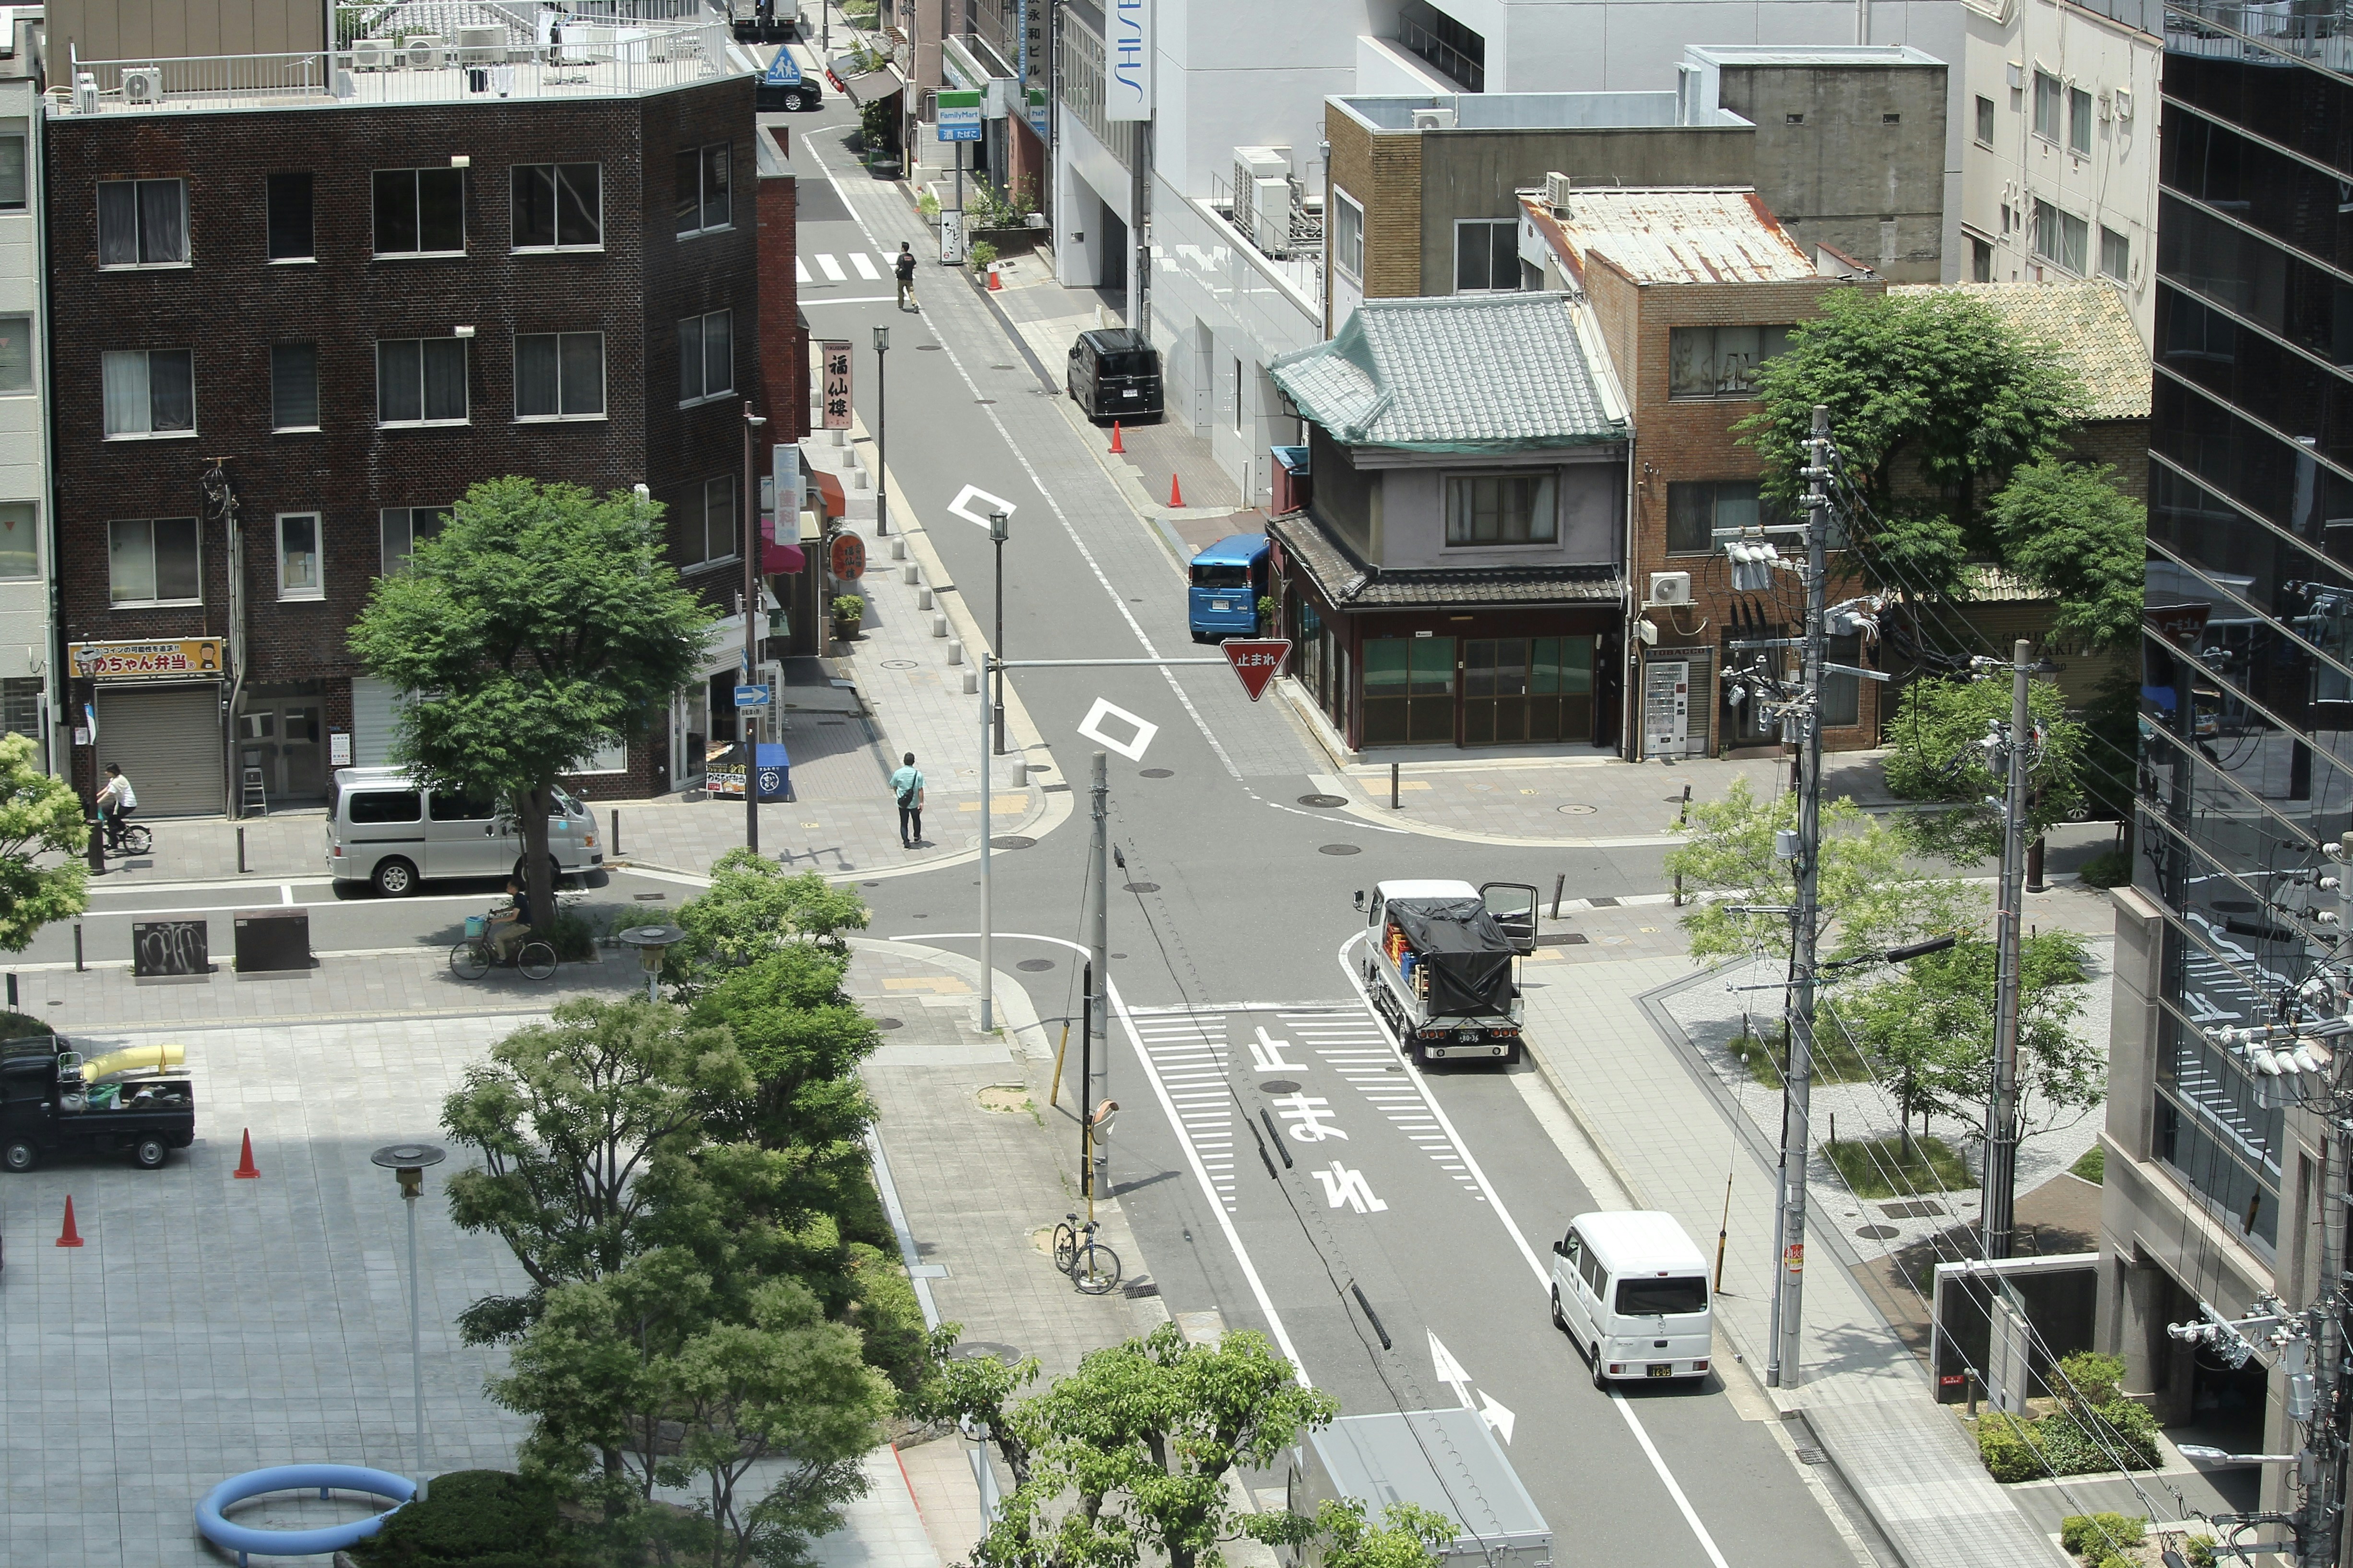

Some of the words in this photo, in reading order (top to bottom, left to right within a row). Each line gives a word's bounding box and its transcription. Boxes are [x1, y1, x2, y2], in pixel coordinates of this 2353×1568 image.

[1028, 0, 1040, 76] 永和ビル
[940, 111, 978, 119] FamilyMart
[943, 130, 954, 140] 酒
[957, 130, 977, 139] たばこ
[1236, 653, 1277, 667] 止まれ
[1247, 1026, 1389, 1214] 止まれ
[1652, 1368, 1670, 1377] 16-05
